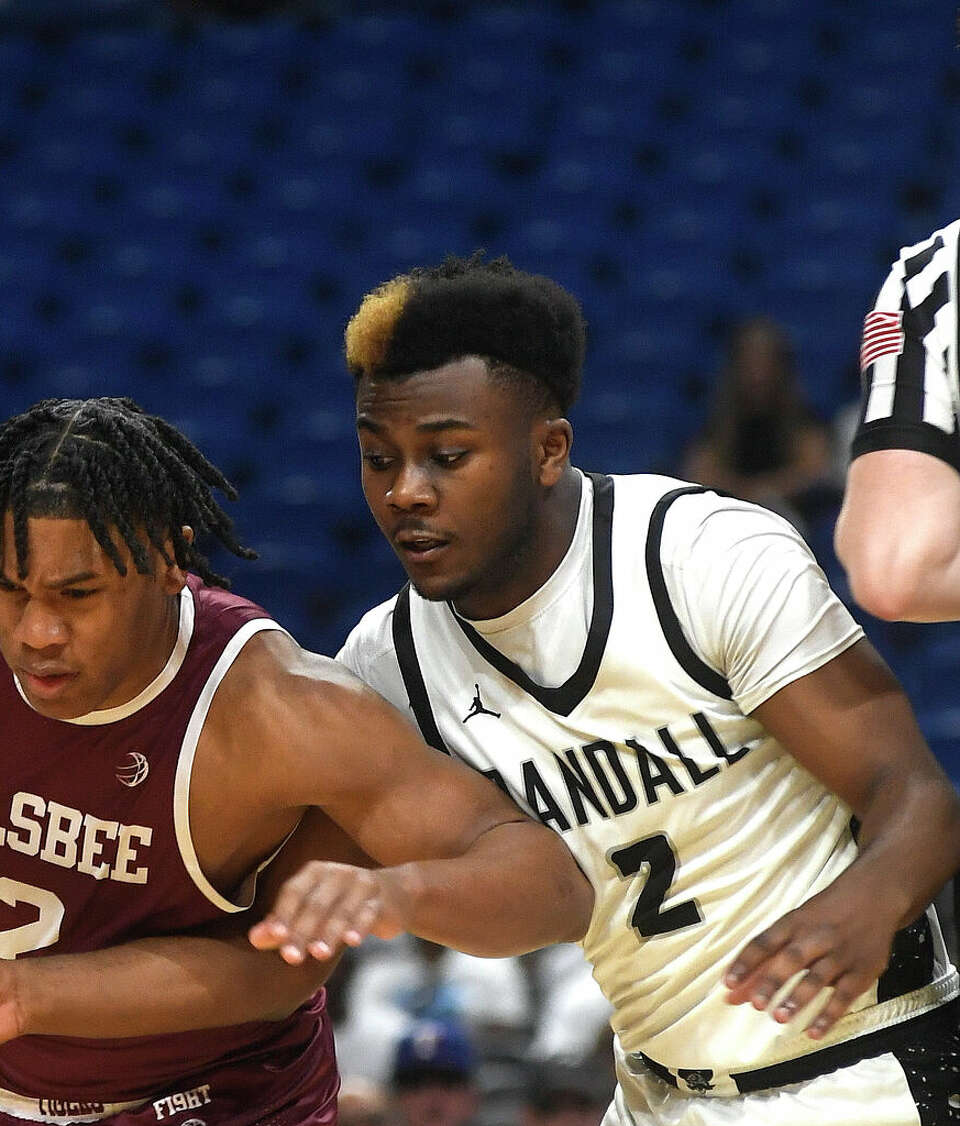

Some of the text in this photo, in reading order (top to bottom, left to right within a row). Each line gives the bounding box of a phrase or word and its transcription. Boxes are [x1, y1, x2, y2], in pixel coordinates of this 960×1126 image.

[481, 711, 752, 832] ANDALL
[607, 831, 705, 941] 2
[152, 1084, 212, 1120] FIGHT
